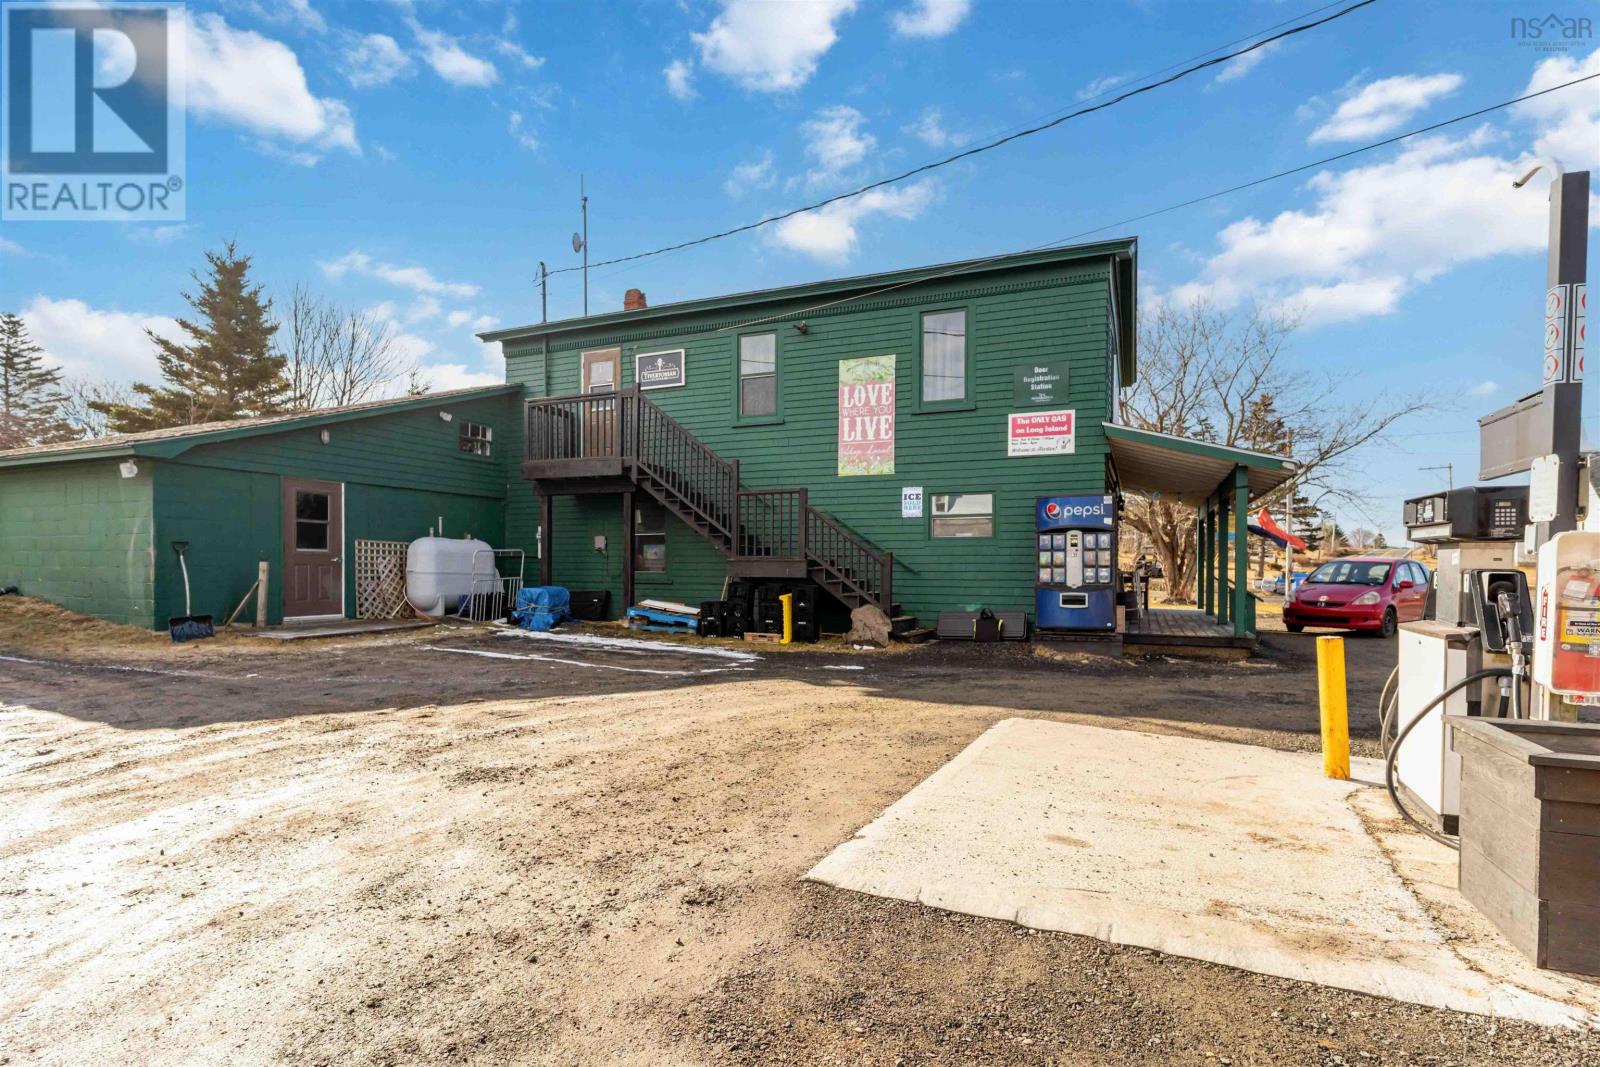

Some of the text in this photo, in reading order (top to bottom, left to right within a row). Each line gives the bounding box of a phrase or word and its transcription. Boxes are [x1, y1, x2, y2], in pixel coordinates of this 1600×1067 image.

[1034, 366, 1049, 374] Deer
[1023, 375, 1060, 383] Registration
[843, 384, 892, 408] LOVE
[842, 406, 892, 417] WHERE YOU
[1031, 416, 1050, 424] ONLY
[1051, 415, 1067, 423] GAS
[843, 416, 892, 441] LIVE
[1064, 504, 1104, 518] pepsi
